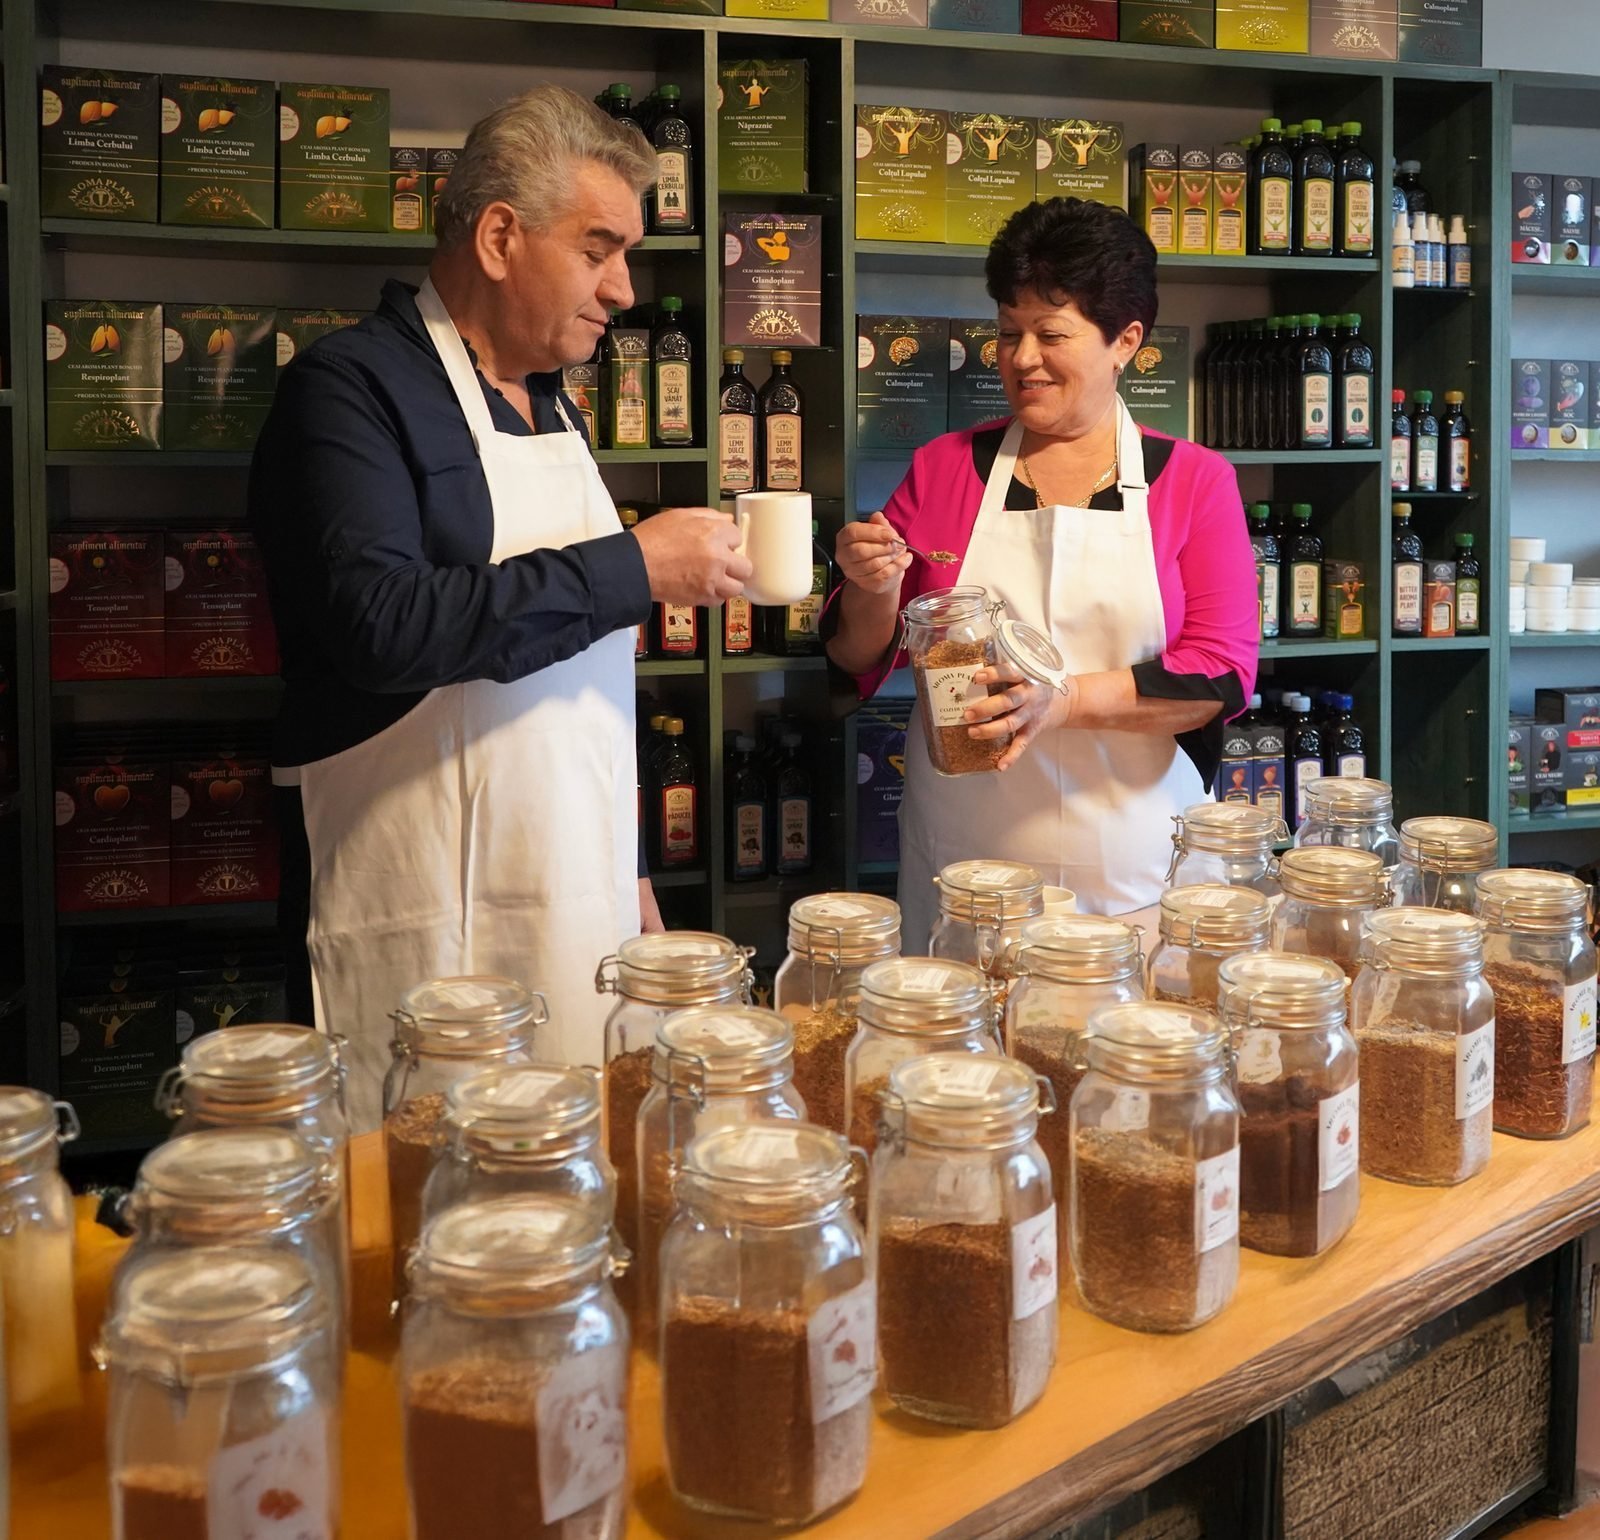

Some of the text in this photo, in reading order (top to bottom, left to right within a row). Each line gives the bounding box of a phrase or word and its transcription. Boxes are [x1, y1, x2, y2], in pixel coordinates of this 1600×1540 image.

[1423, 2, 1459, 13] Calmoplant
[61, 77, 141, 91] supliment alimentar
[737, 121, 772, 130] Năpraznic
[68, 138, 133, 150] Limba Cerbului
[187, 145, 250, 157] Limba Cerbului
[305, 152, 366, 163] Limba Cerbului
[878, 168, 927, 178] Colțul Lupului
[967, 174, 1015, 185] Colțul Lupului
[1058, 178, 1104, 189] Colțul Lupului
[68, 177, 135, 208] AROMA PLANT
[751, 276, 795, 286] Glandoplant
[64, 308, 144, 320] supliment alimentar
[181, 311, 260, 321] supliment alimentar
[330, 317, 360, 325] aliment
[746, 309, 802, 333] AROMA PLANT
[81, 373, 130, 384] Respiroplant
[197, 375, 244, 385] Respiroplant
[885, 379, 924, 389] Calmoplant
[976, 382, 1003, 390] Calmopl
[1131, 386, 1167, 395] Calmoplant
[111, 409, 140, 437] PLANT
[728, 446, 745, 454] DULCE
[775, 446, 793, 454] DULCE
[68, 541, 107, 551] supliment
[87, 603, 129, 613] Tensoplant
[201, 601, 242, 611] Tensoplant
[191, 637, 225, 662] AROMA
[932, 673, 954, 689] AROMA
[75, 772, 155, 784] supliment alimentar
[188, 769, 227, 780] supliment
[203, 828, 251, 838] Cardioplant
[89, 834, 138, 845] Cardioplant
[79, 999, 157, 1015] supliment alimentar
[93, 1062, 143, 1074] Dermoplant
